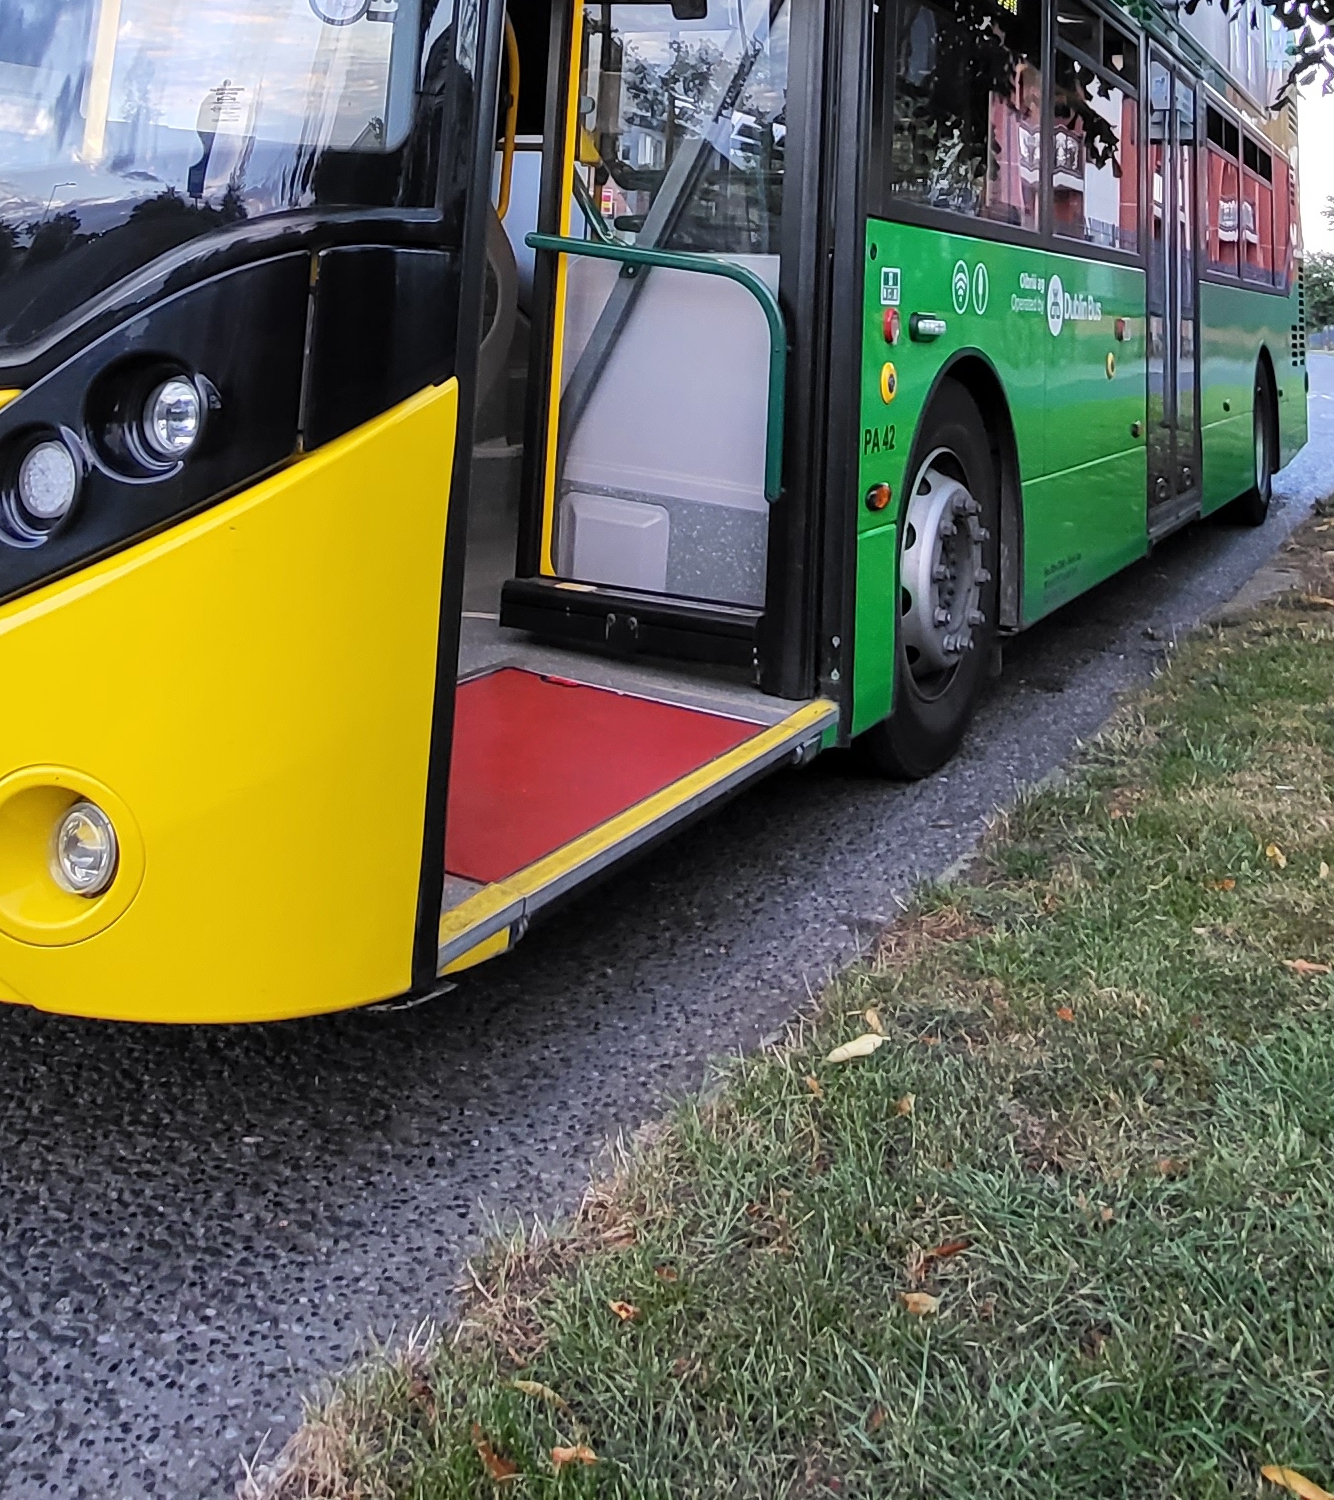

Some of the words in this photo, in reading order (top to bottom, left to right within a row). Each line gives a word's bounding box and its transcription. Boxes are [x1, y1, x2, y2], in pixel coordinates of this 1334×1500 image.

[1064, 292, 1087, 320] Dublin
[1088, 295, 1102, 321] Bus
[864, 428, 880, 455] PA
[883, 425, 895, 450] 42
